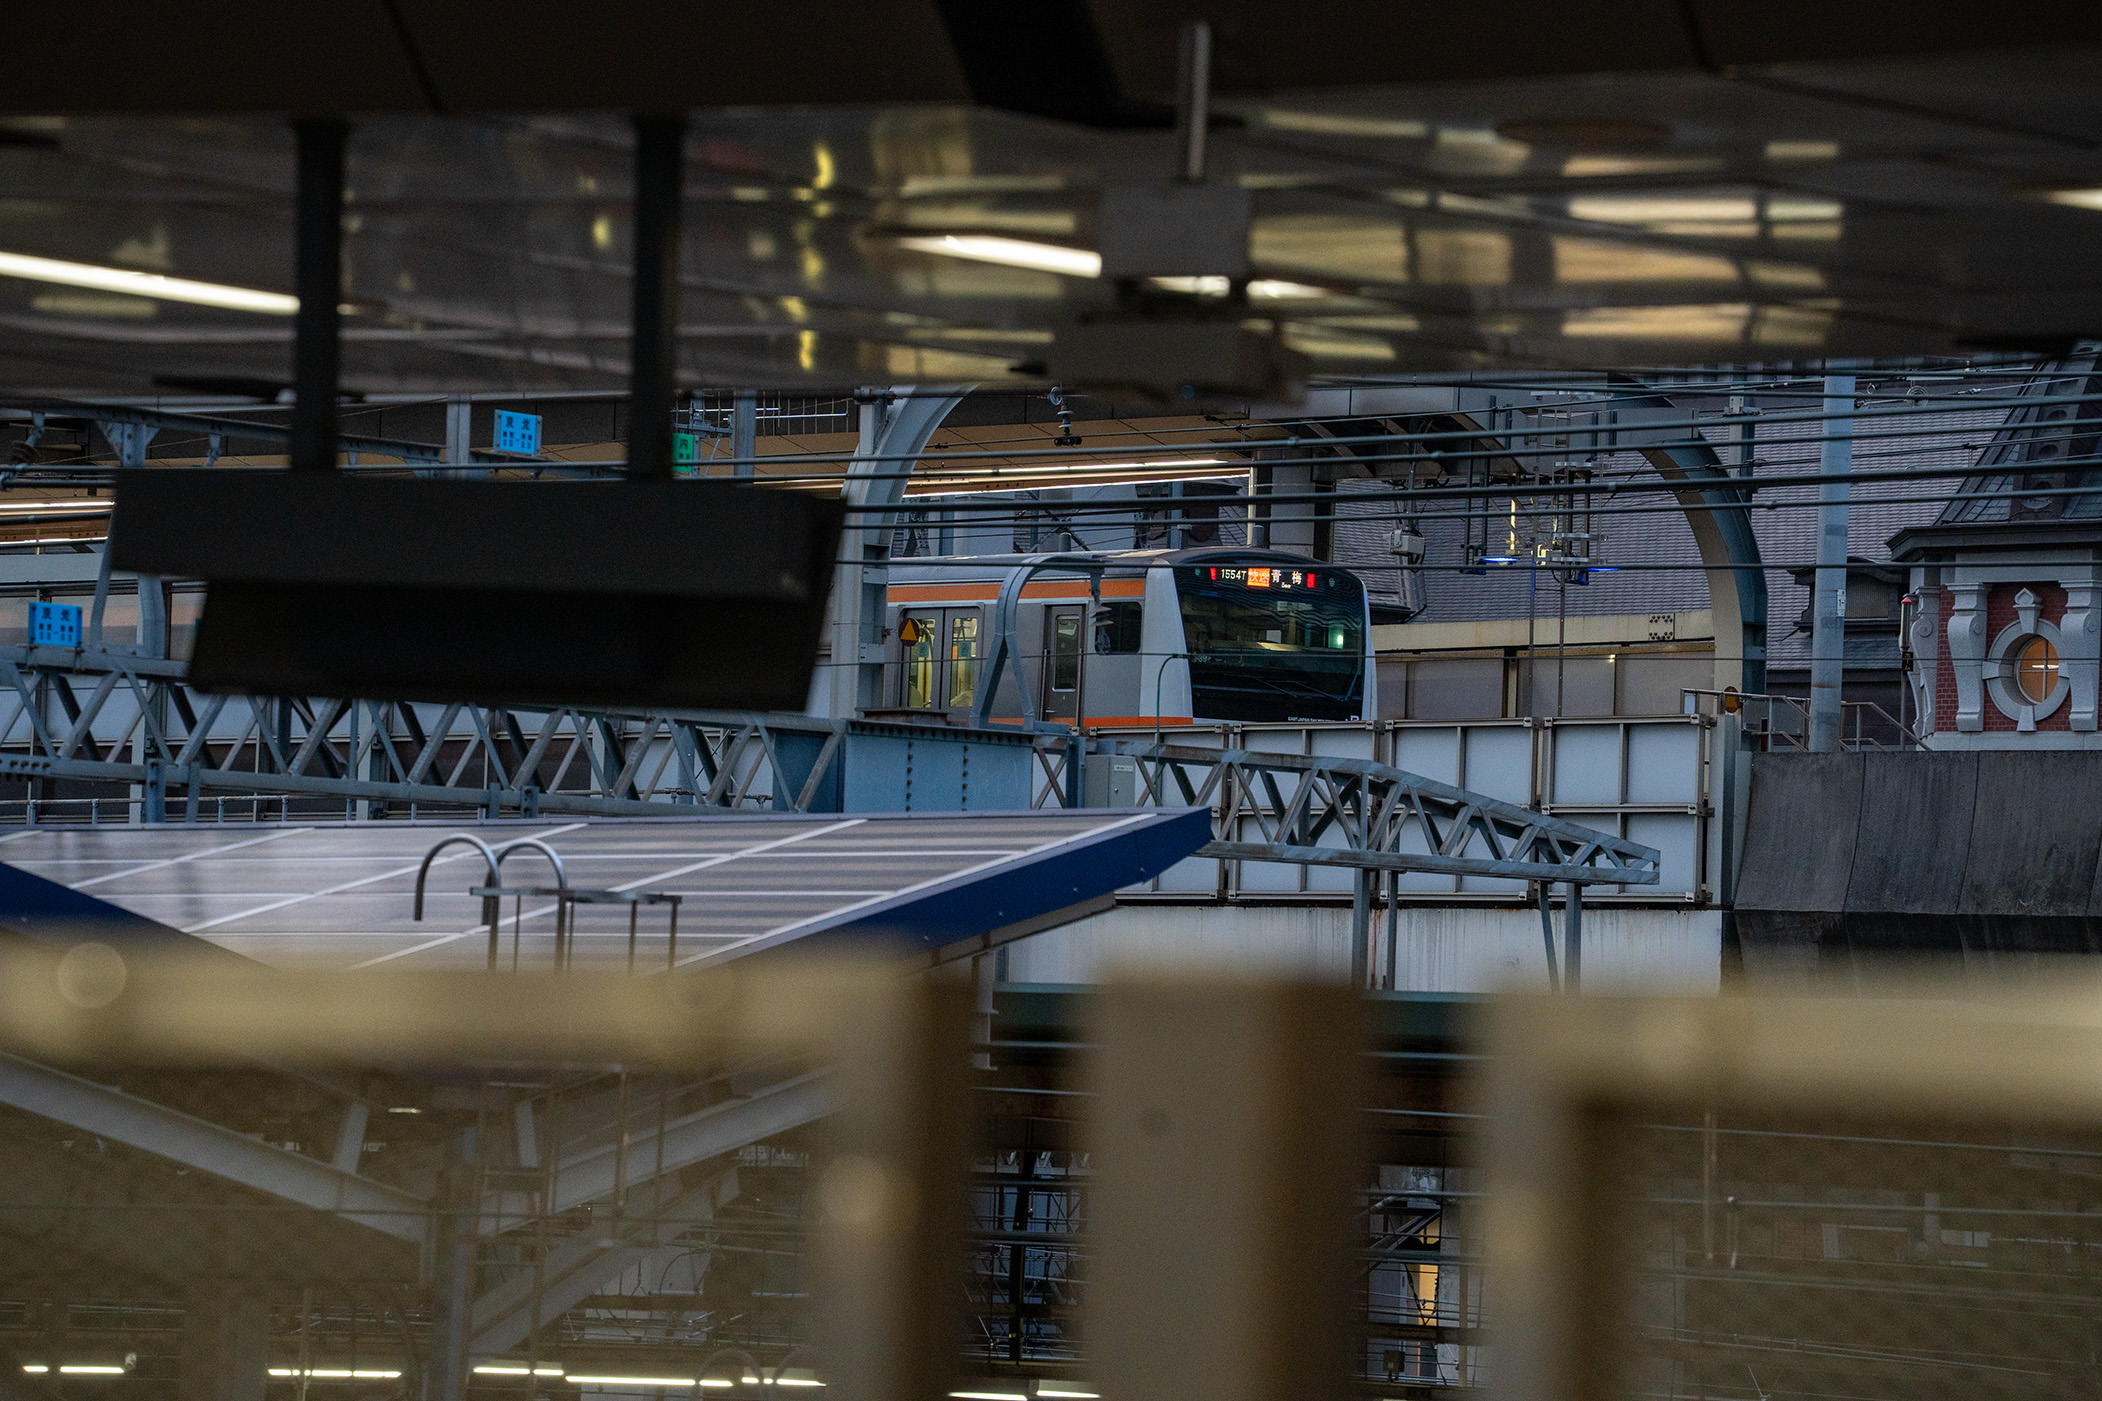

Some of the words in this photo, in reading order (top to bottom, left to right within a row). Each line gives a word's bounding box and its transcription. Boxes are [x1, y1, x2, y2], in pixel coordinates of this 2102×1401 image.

[1221, 568, 1247, 580] 1554T
[1248, 568, 1270, 584] 快速
[1271, 569, 1302, 585] 青梅
